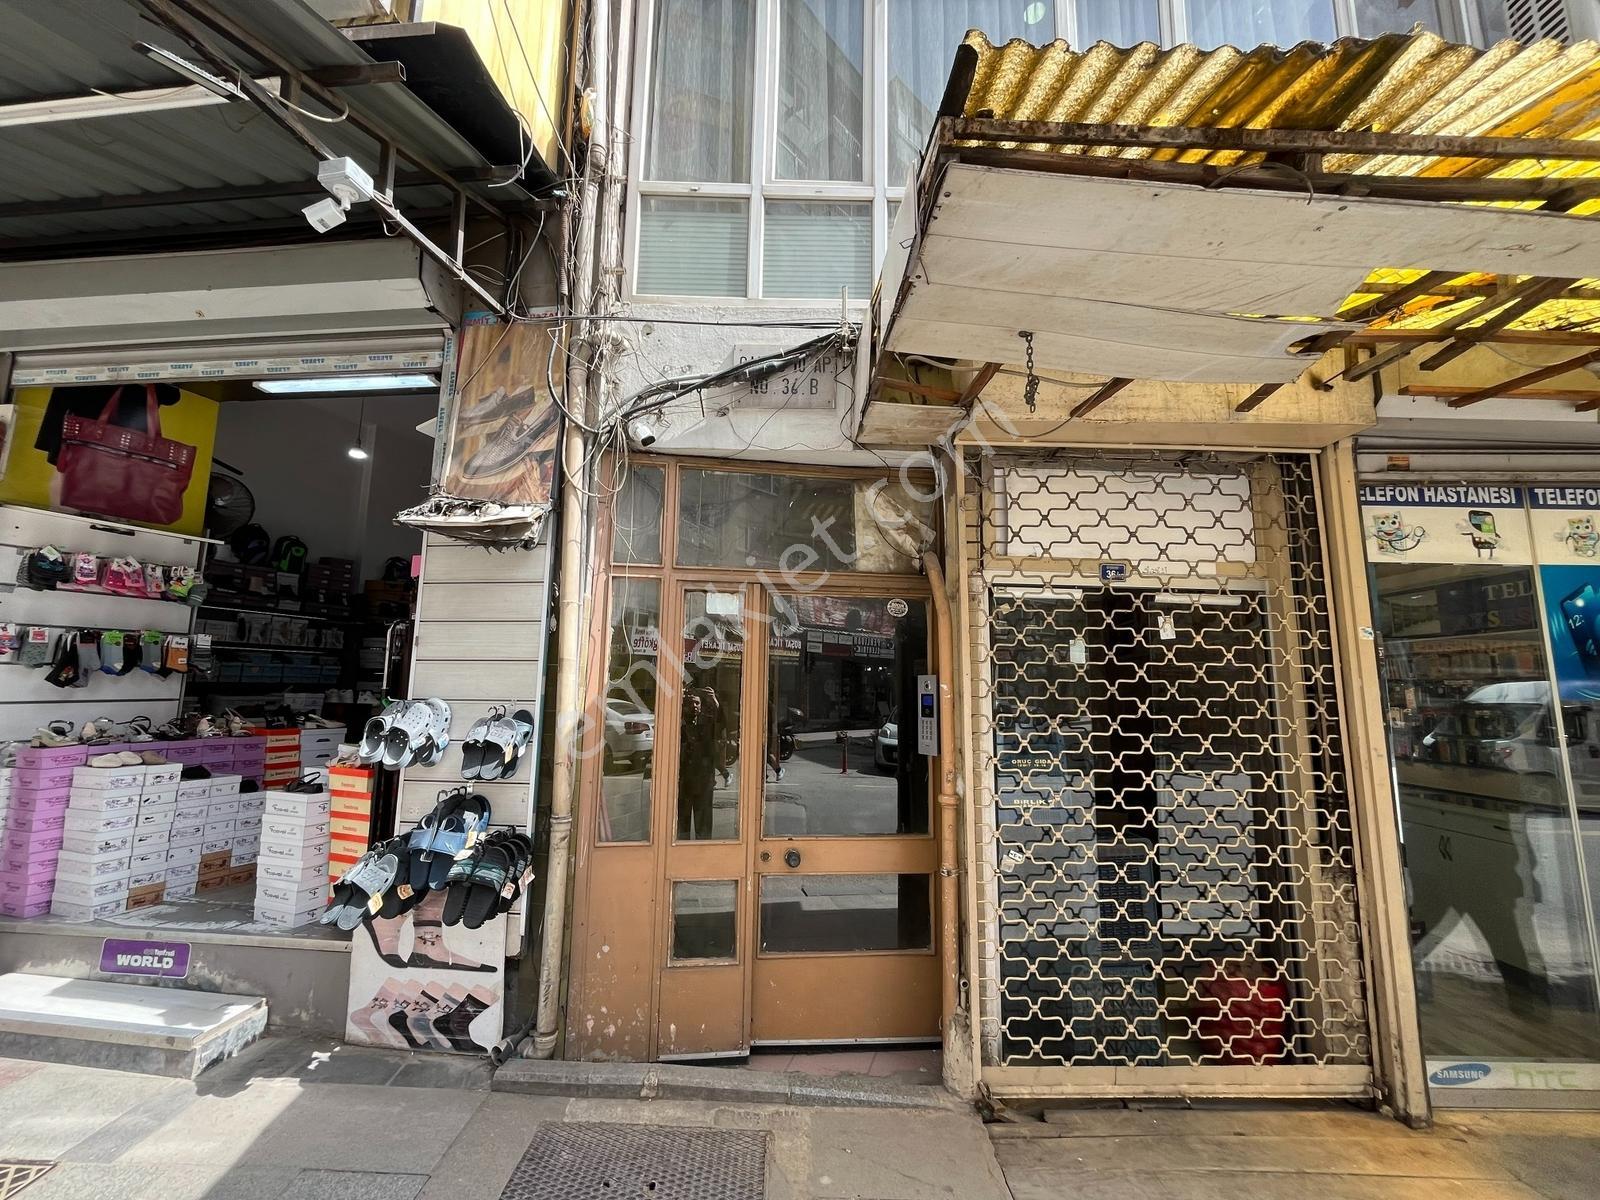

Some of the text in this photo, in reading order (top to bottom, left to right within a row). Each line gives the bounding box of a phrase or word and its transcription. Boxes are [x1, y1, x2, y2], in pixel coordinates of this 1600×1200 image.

[1424, 486, 1516, 504] HASTANESI
[1534, 488, 1600, 506] TELEFO
[117, 954, 173, 969] WORLD
[1436, 1070, 1485, 1079] SAMSUNG
